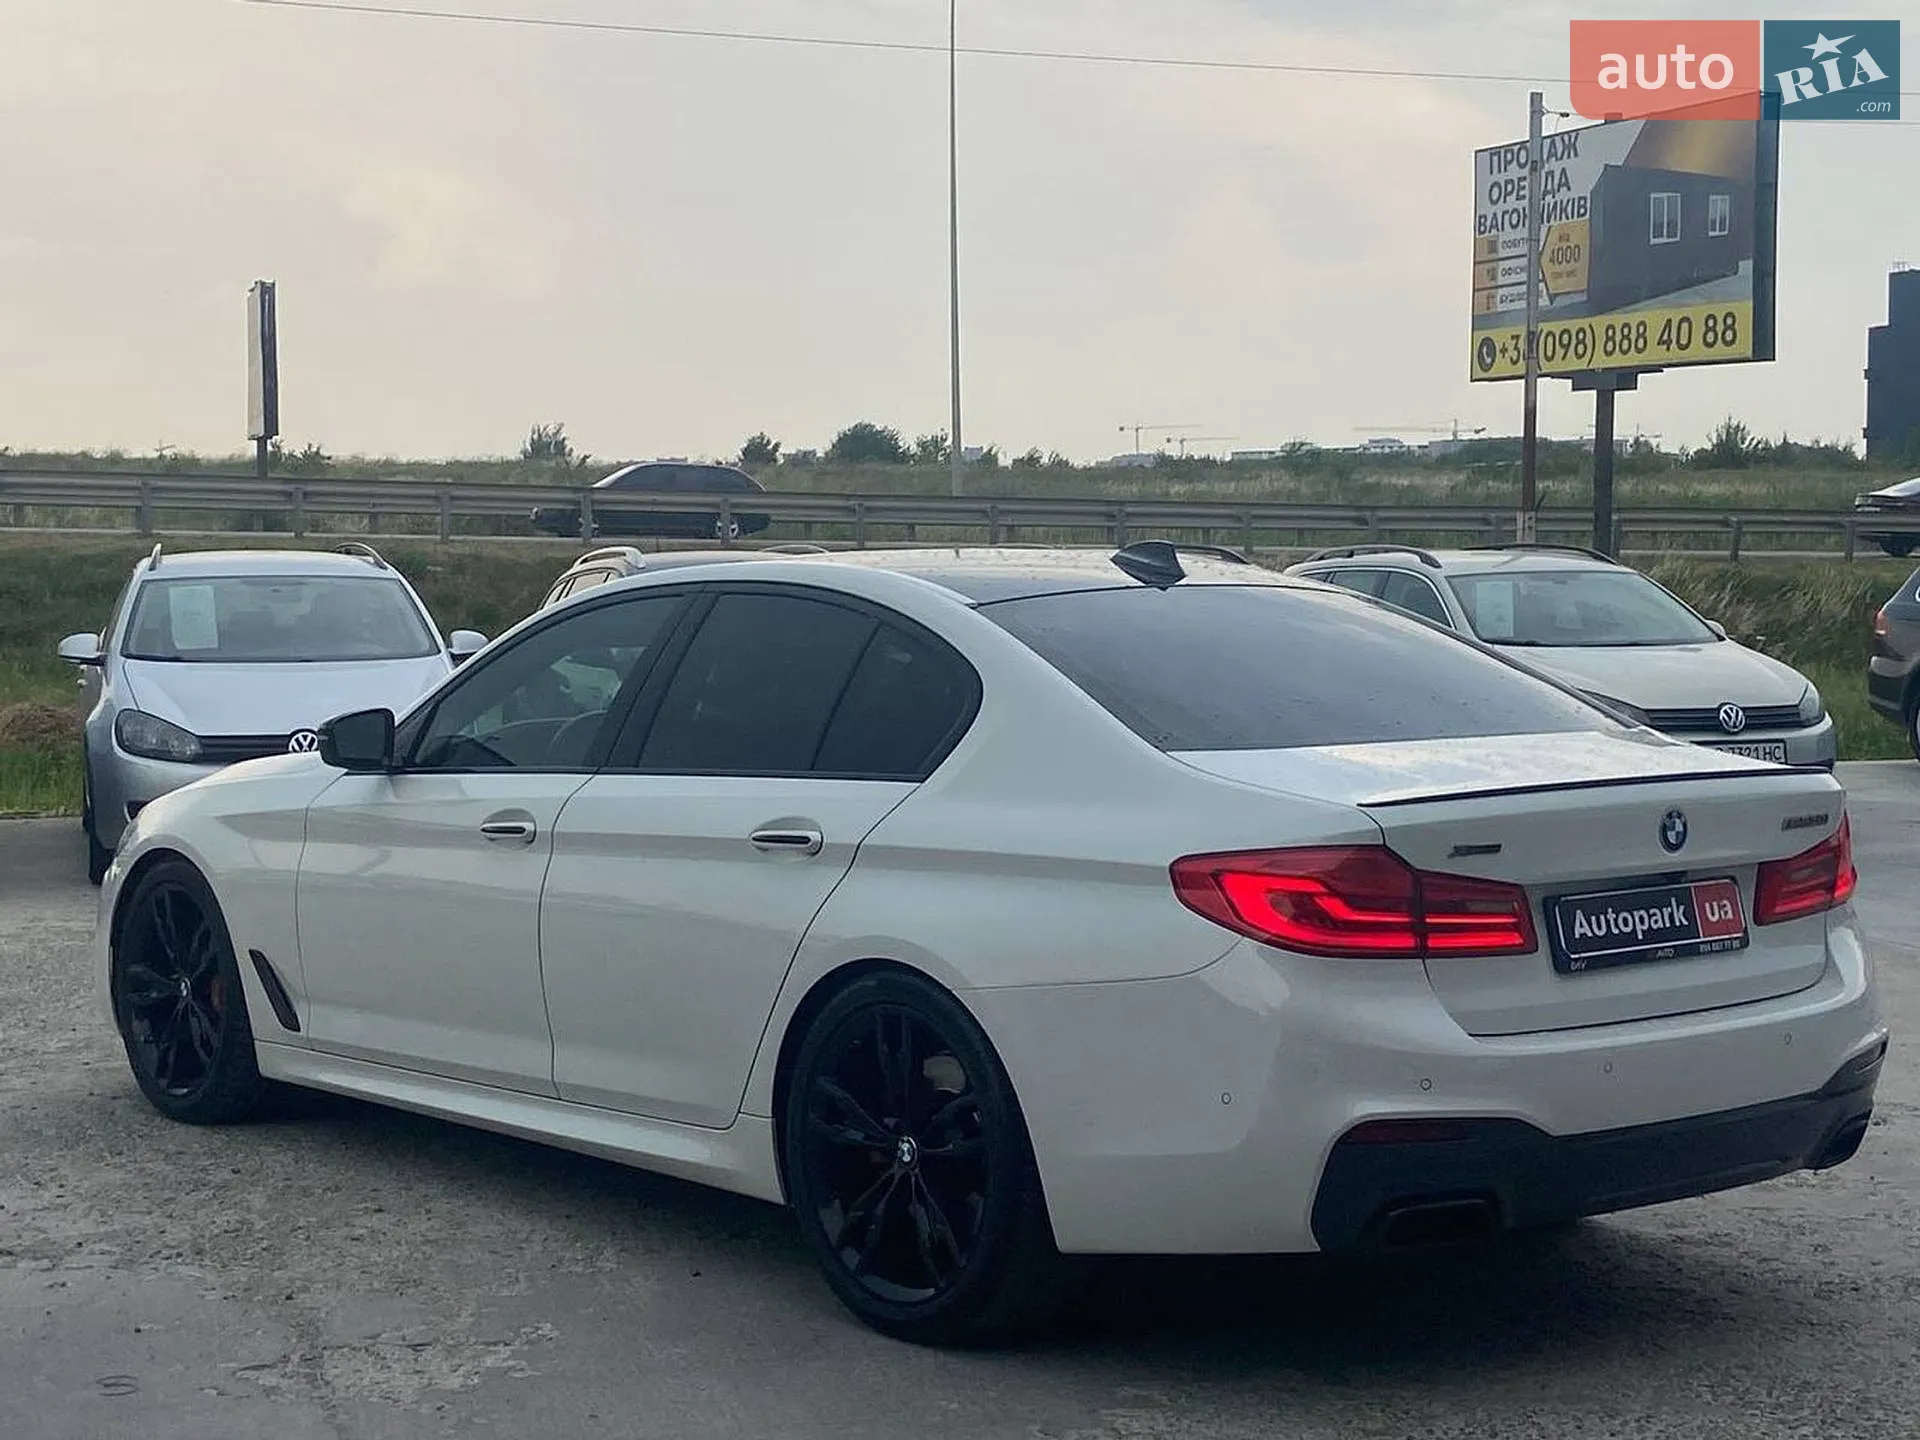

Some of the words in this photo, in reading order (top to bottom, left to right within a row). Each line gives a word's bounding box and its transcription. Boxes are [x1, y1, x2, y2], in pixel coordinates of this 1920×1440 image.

[1488, 167, 1572, 206] ОРЕДА
[1477, 196, 1589, 236] ВАГОИКІВ
[1549, 244, 1582, 265] 4000
[1603, 320, 1648, 357] 888
[1656, 316, 1693, 351] 40
[1702, 311, 1738, 348] 88
[1574, 897, 1688, 940] Autopark
[1704, 899, 1734, 923] ua
